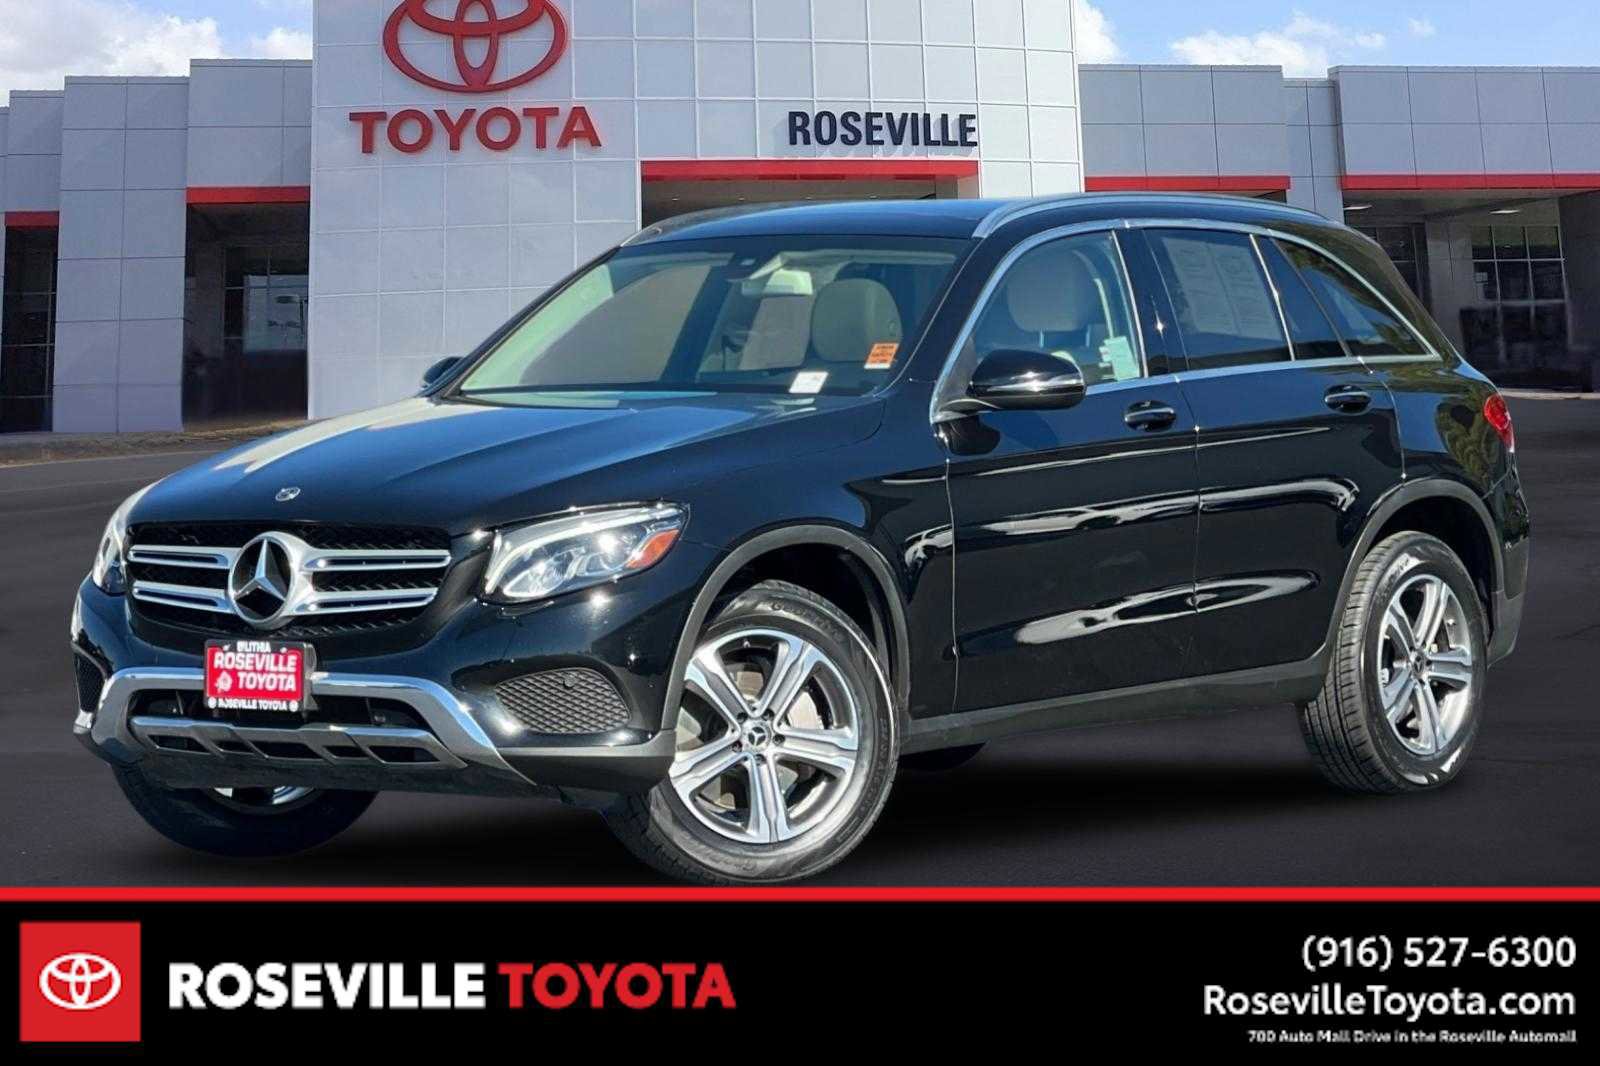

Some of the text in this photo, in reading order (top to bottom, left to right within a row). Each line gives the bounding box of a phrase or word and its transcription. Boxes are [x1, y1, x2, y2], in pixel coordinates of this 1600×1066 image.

[349, 106, 602, 154] TOYOTA
[788, 110, 978, 147] ROSEVILLE
[213, 652, 297, 672] ROSEVILLE
[237, 672, 296, 691] TOYOTA
